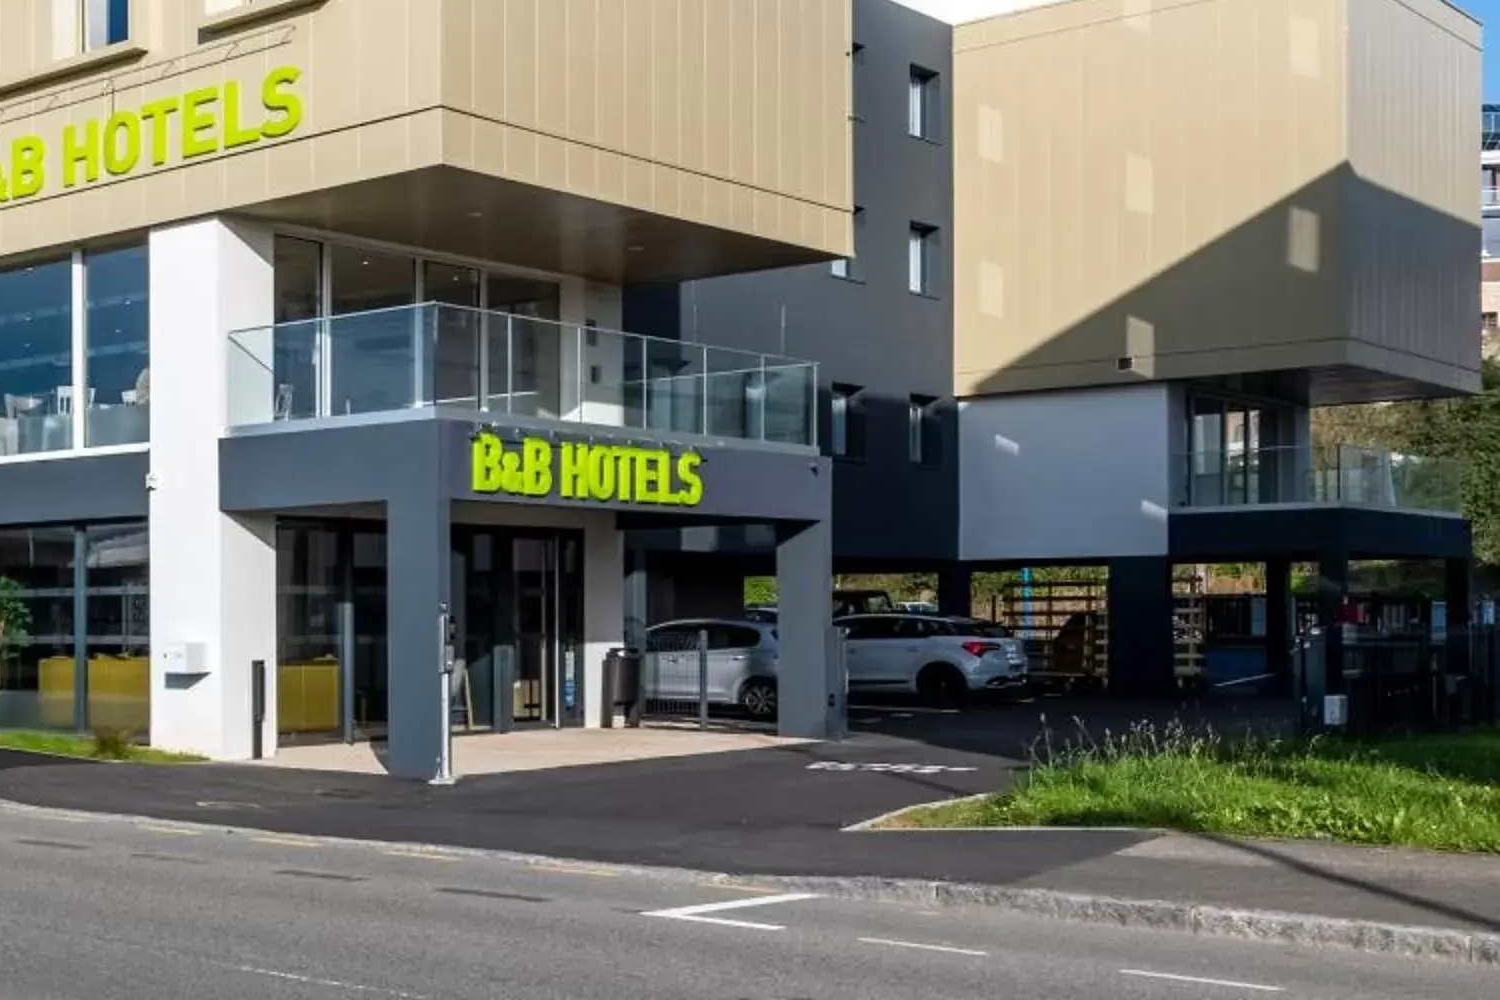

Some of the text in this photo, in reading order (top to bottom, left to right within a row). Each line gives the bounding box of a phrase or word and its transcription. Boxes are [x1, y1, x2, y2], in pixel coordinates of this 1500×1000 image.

[62, 64, 304, 188] HOTELS
[472, 432, 705, 507] B&B HOTELS
